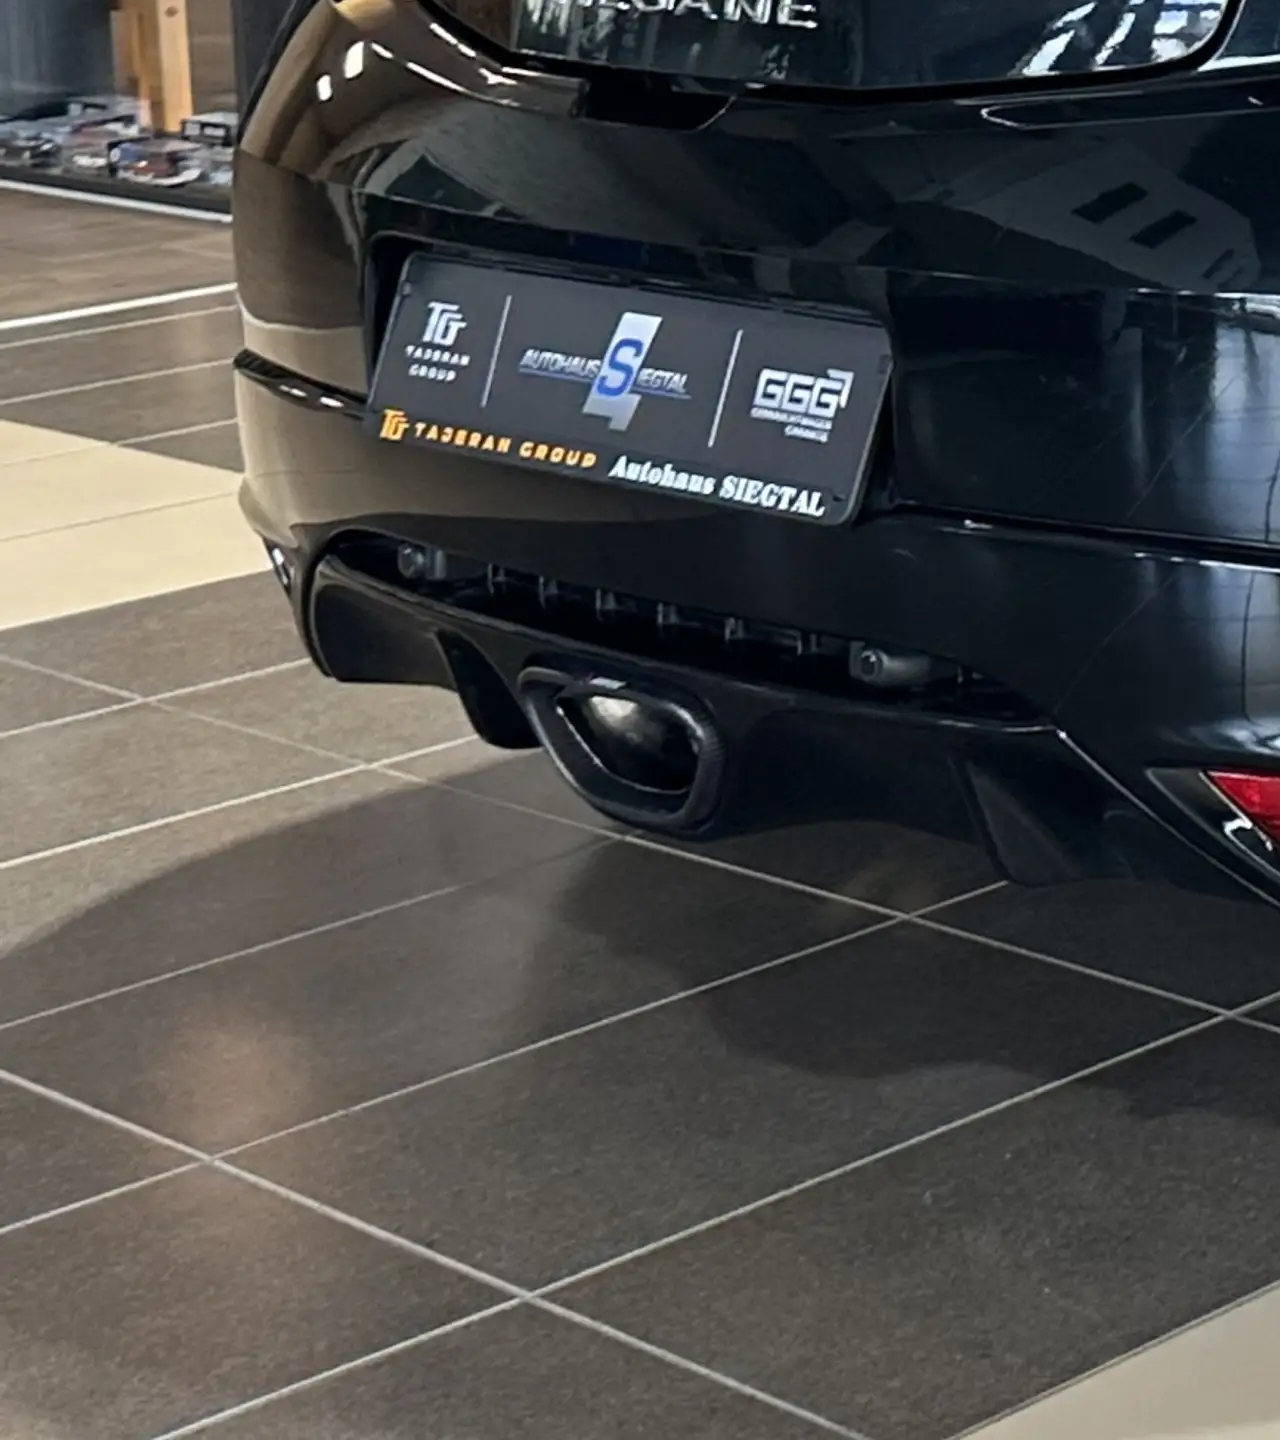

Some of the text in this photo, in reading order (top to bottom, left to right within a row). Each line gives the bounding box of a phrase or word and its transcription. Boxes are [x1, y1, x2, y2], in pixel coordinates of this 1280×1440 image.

[408, 363, 457, 382] GROUP
[519, 348, 602, 379] AUTOHAUS
[753, 368, 844, 419] GGG
[518, 440, 598, 469] GROUP
[607, 454, 826, 518] Autohaus SIEGTAL
